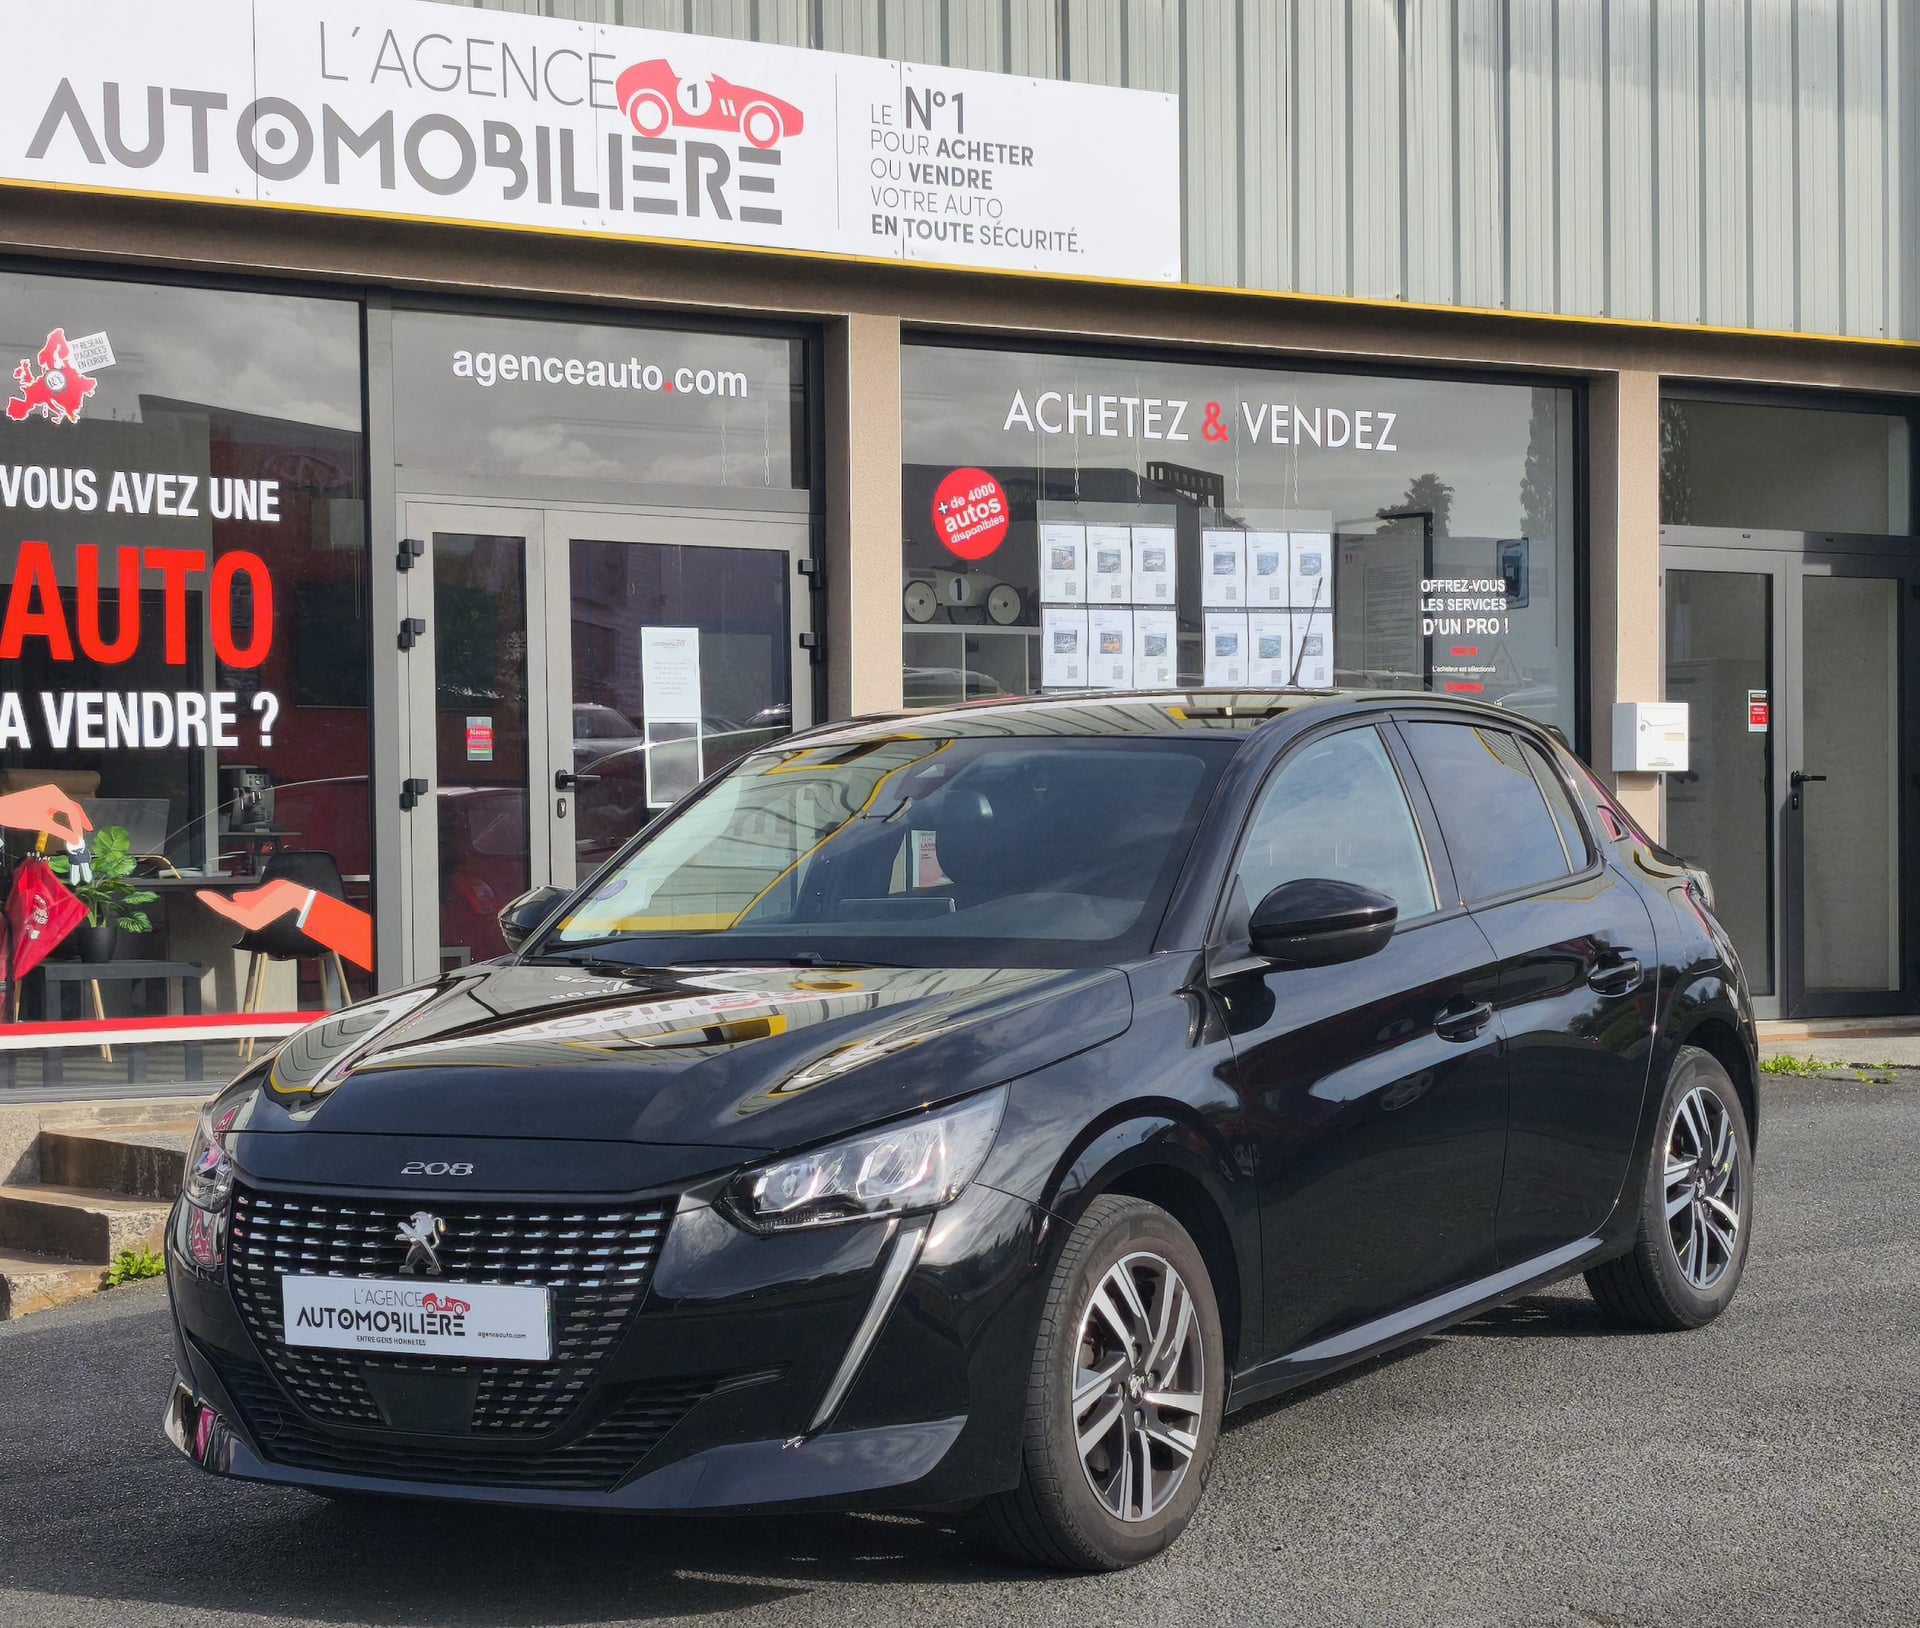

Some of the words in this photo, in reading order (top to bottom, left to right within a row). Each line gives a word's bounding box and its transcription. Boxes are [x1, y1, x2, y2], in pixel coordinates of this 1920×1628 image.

[319, 21, 618, 111] L'AGENCE
[686, 83, 698, 109] 1
[871, 103, 892, 127] LE
[871, 129, 929, 157] POUR
[936, 137, 1034, 167] ACHETER
[871, 157, 902, 181] OU
[909, 162, 993, 190] VENDRE
[871, 186, 937, 213] VOTRE
[944, 194, 1003, 219] AUTO
[871, 214, 898, 236] EN
[904, 217, 974, 244] TOUTE
[979, 220, 1085, 254] SÉCURITÉ.
[452, 349, 748, 398] agenceauto.com
[1003, 389, 1189, 441] ACHETEZ
[1201, 402, 1229, 443] &
[1242, 402, 1398, 452] VENDEZ
[0, 465, 98, 511] VOUS
[107, 471, 199, 517] AVEZ
[210, 477, 280, 522] UNE
[950, 496, 966, 508] de
[968, 482, 996, 502] 4000
[944, 498, 1001, 533] autos
[951, 515, 1005, 544] disponibles
[955, 578, 962, 600] 1
[1420, 579, 1506, 593] OFFREZ-VOUS
[0, 541, 273, 669] AUTO
[1421, 598, 1444, 611] LES
[1447, 598, 1507, 611] SERVICES
[1423, 618, 1461, 635] D'UN
[1466, 617, 1500, 635] PRO
[1504, 617, 1509, 635] !
[0, 692, 30, 749] A
[40, 692, 239, 749] VENDRE
[253, 691, 280, 748] ?
[401, 1161, 474, 1176] 208
[353, 1288, 423, 1308] L'AGENCE
[356, 1335, 375, 1344] ENTRE
[376, 1336, 393, 1345] GENS
[477, 1330, 526, 1340] agenceauto.com
